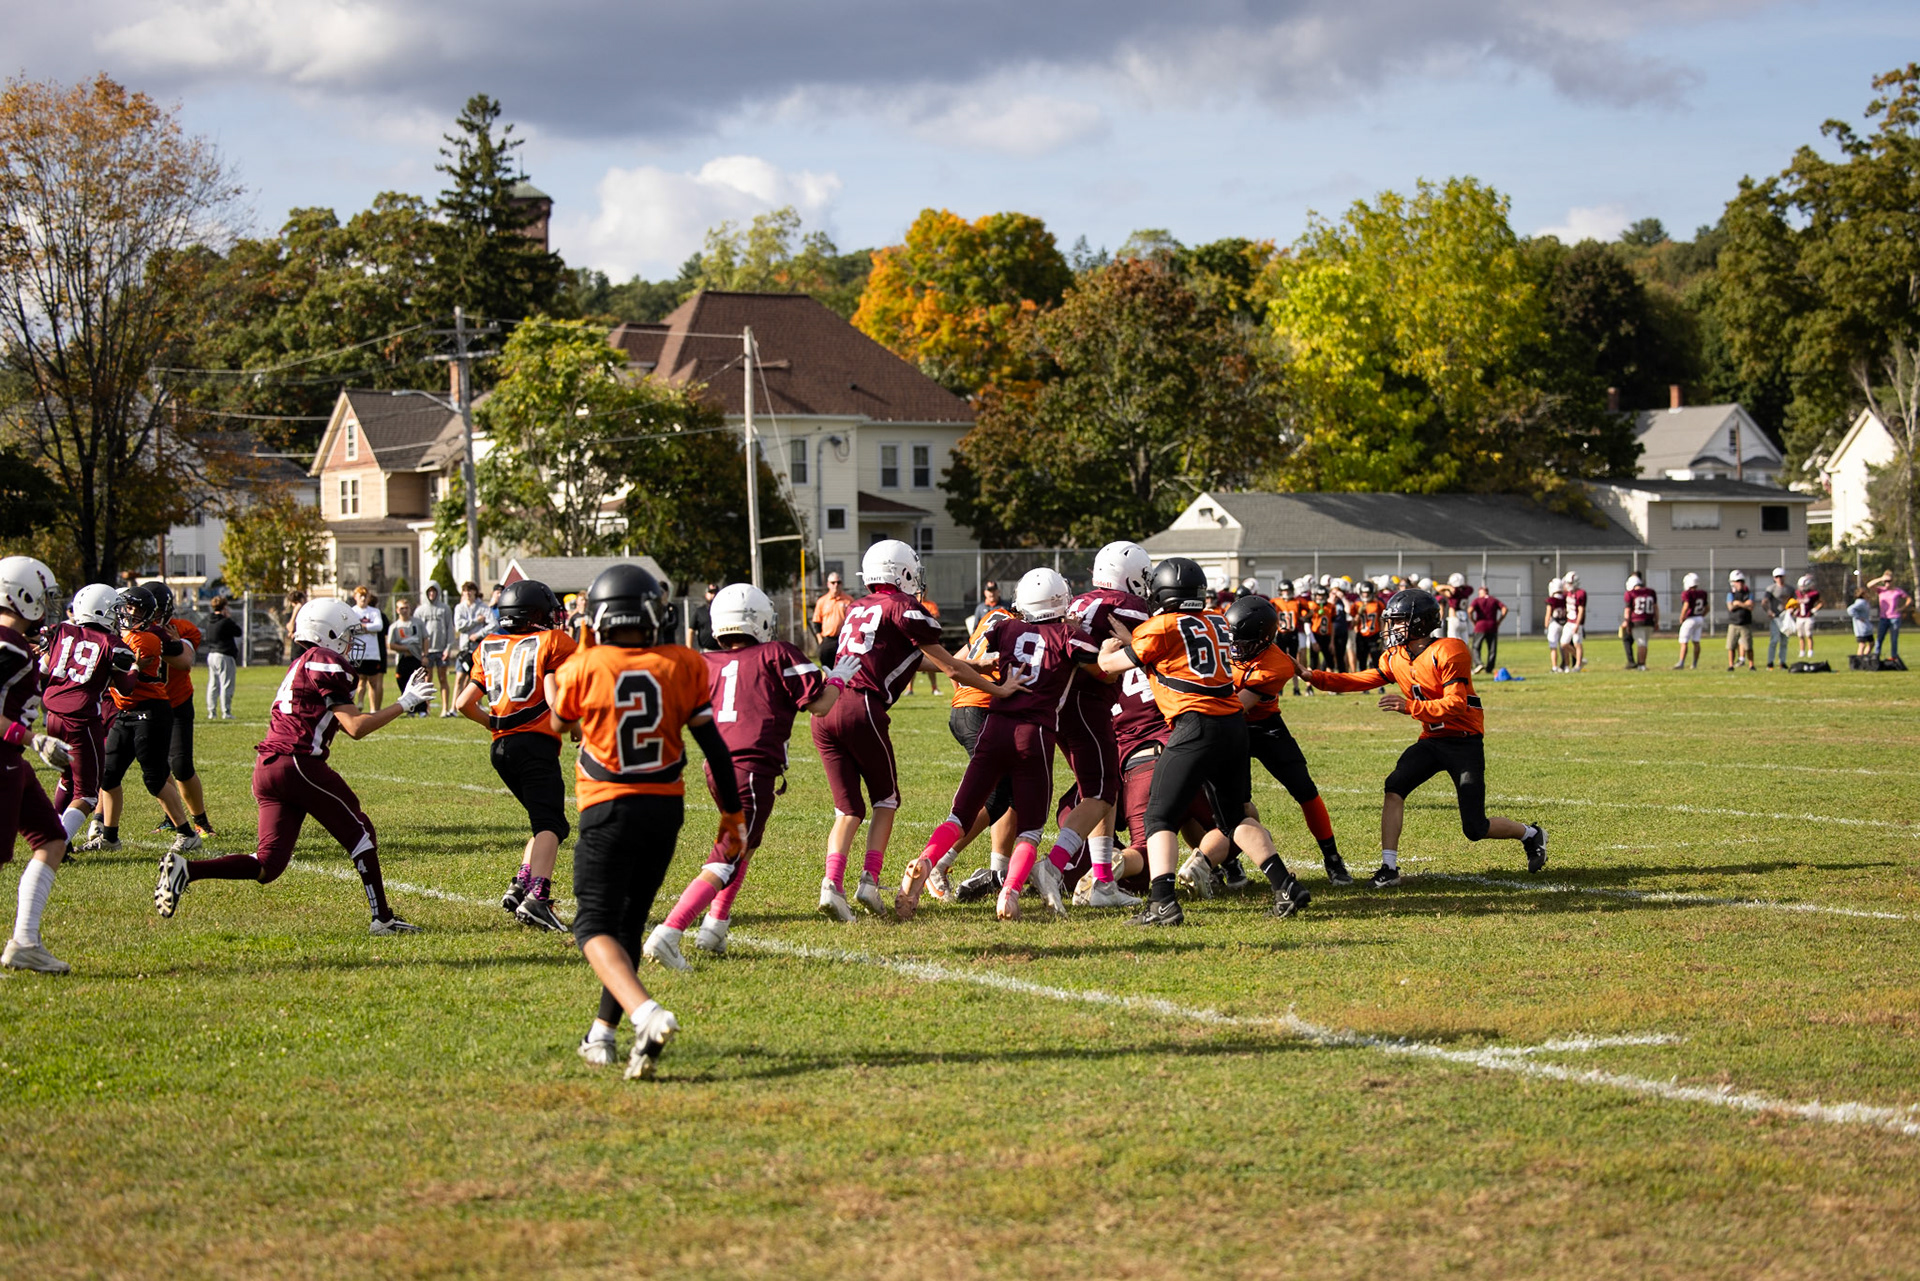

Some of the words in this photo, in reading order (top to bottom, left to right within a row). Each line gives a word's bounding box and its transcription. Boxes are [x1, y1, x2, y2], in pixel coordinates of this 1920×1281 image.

[52, 635, 100, 684] 19
[836, 605, 883, 655] 63
[1013, 631, 1046, 686] 9
[1177, 615, 1233, 678] 65
[480, 635, 540, 706] 50
[717, 660, 739, 723] 1
[1110, 666, 1156, 717] 4
[614, 669, 664, 775] 2
